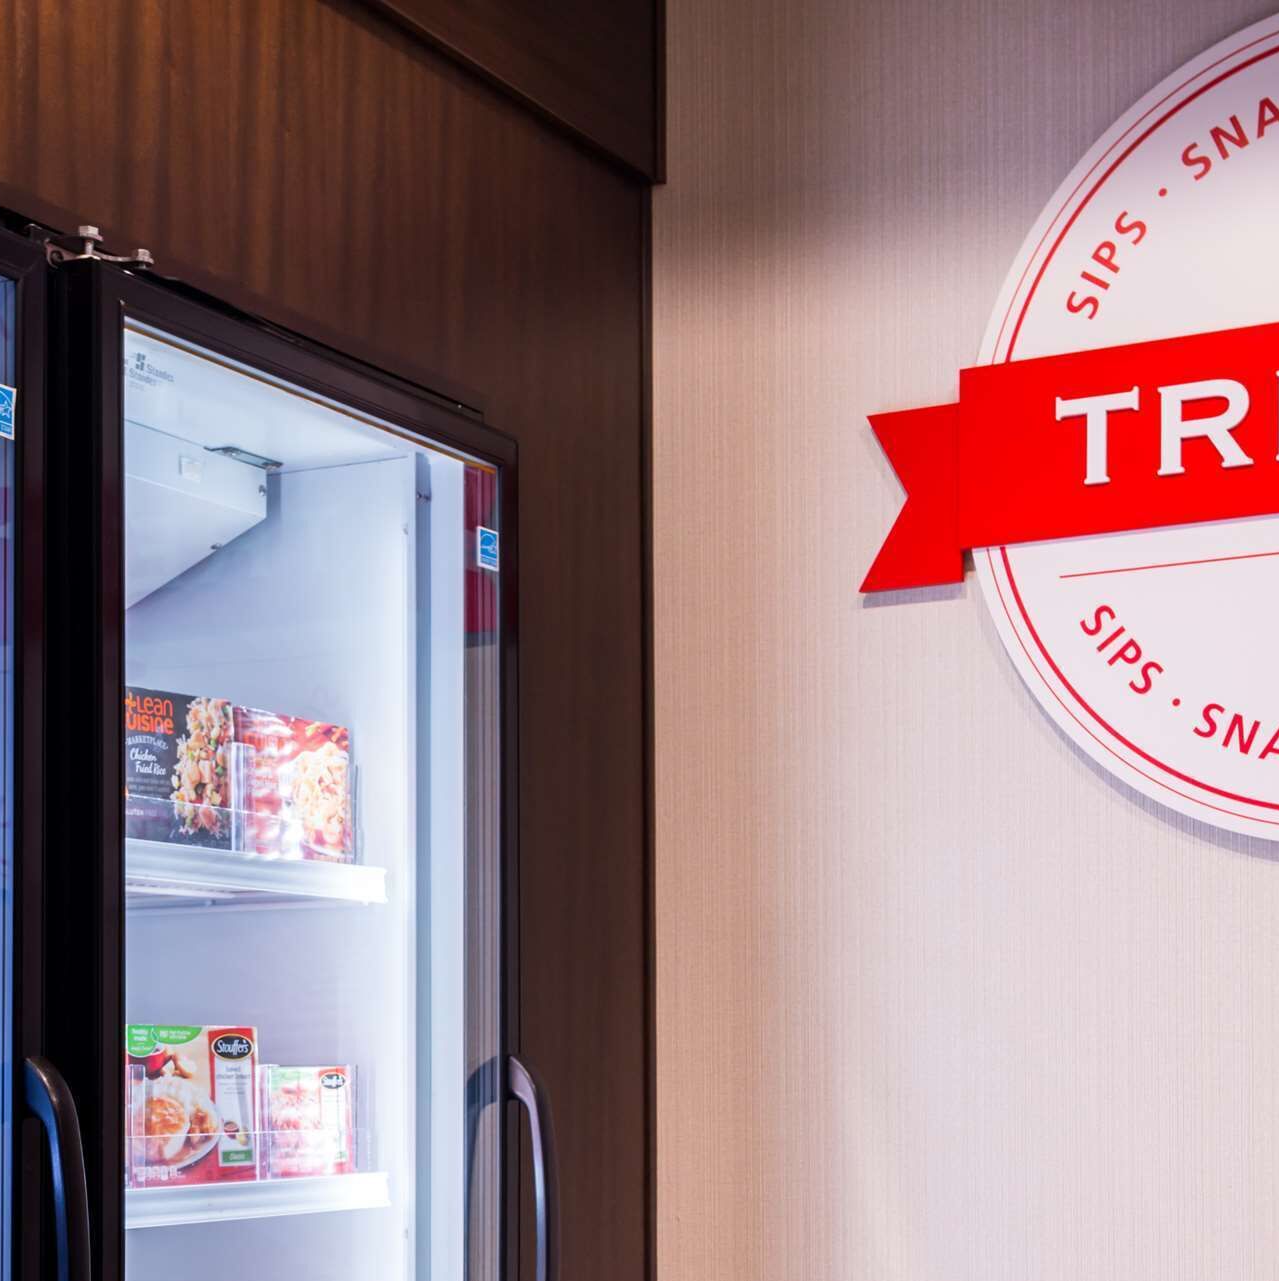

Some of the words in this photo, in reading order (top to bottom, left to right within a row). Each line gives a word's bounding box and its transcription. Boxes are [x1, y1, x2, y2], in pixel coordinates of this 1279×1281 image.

[1066, 212, 1147, 320] SIPS
[1079, 603, 1164, 698] SIPS
[129, 747, 157, 762] Chicken
